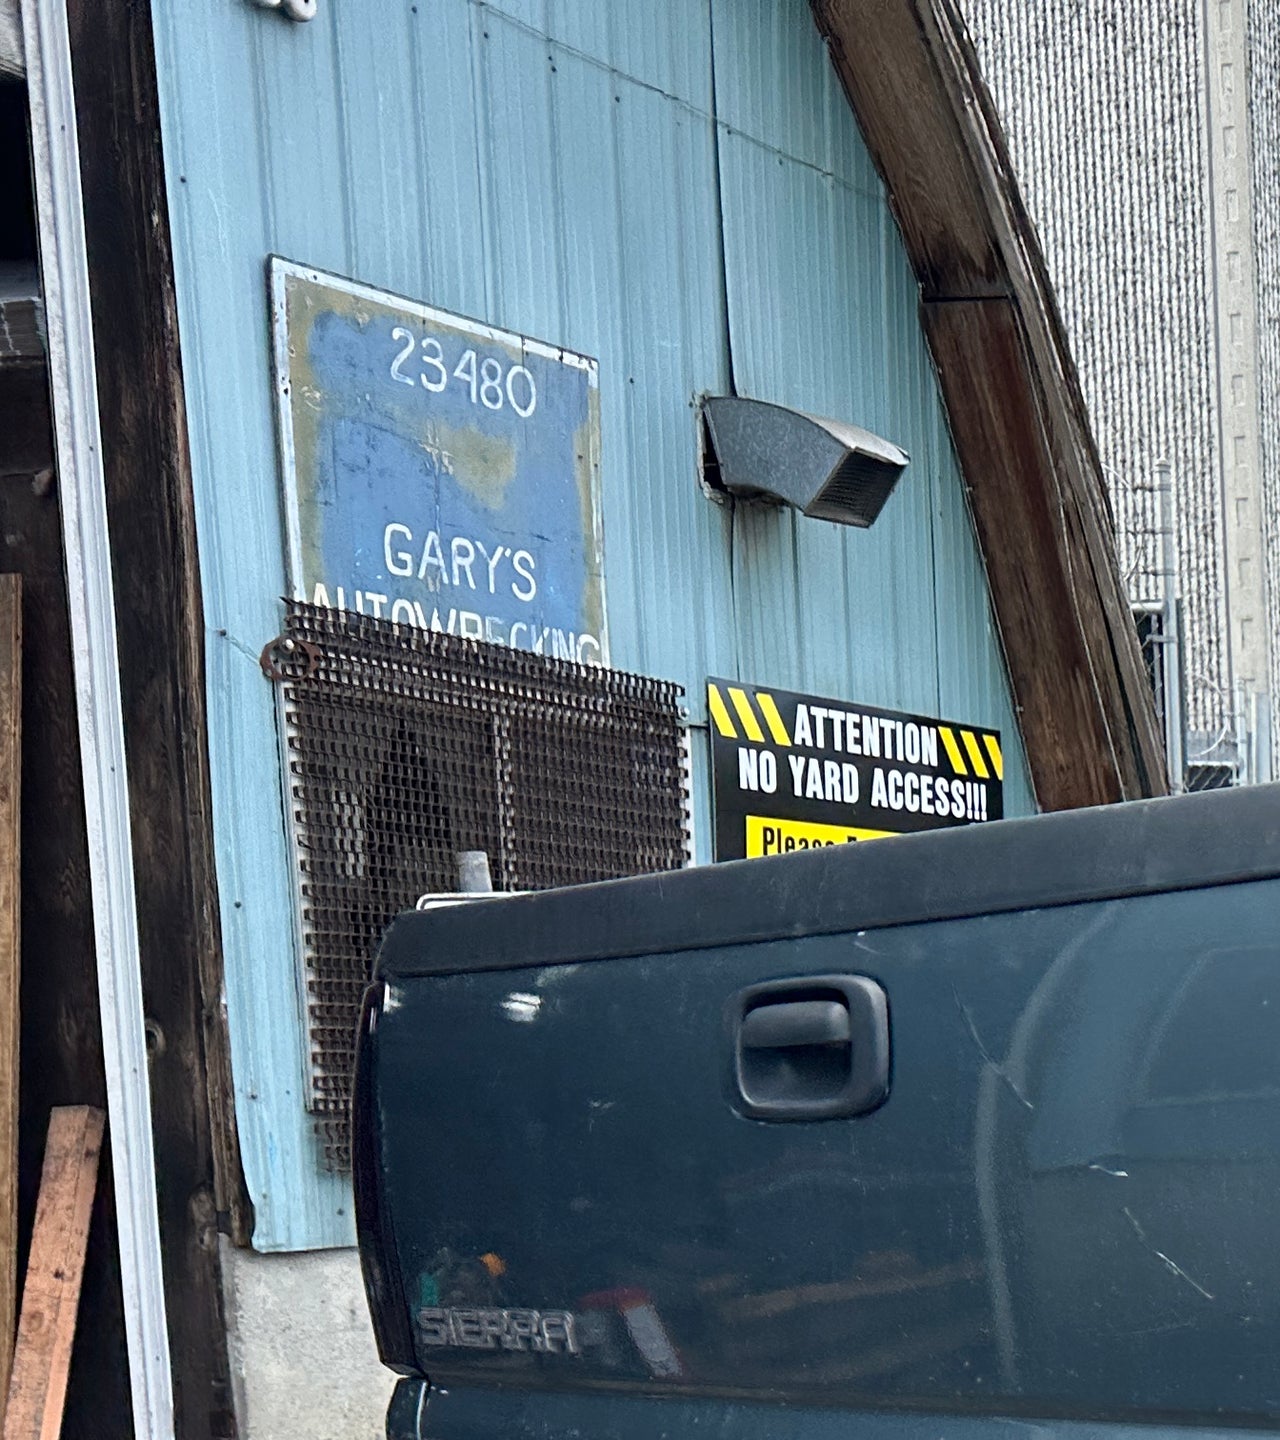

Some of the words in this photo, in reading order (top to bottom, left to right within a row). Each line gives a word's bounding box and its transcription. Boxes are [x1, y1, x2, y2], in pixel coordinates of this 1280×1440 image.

[390, 327, 537, 418] 23480
[383, 522, 537, 602] GARY'S
[794, 703, 938, 768] ATTENTION
[738, 747, 777, 794] NO
[788, 754, 860, 804] YARD
[870, 767, 988, 821] ACCESS!!!
[418, 1306, 576, 1352] SIERRA
